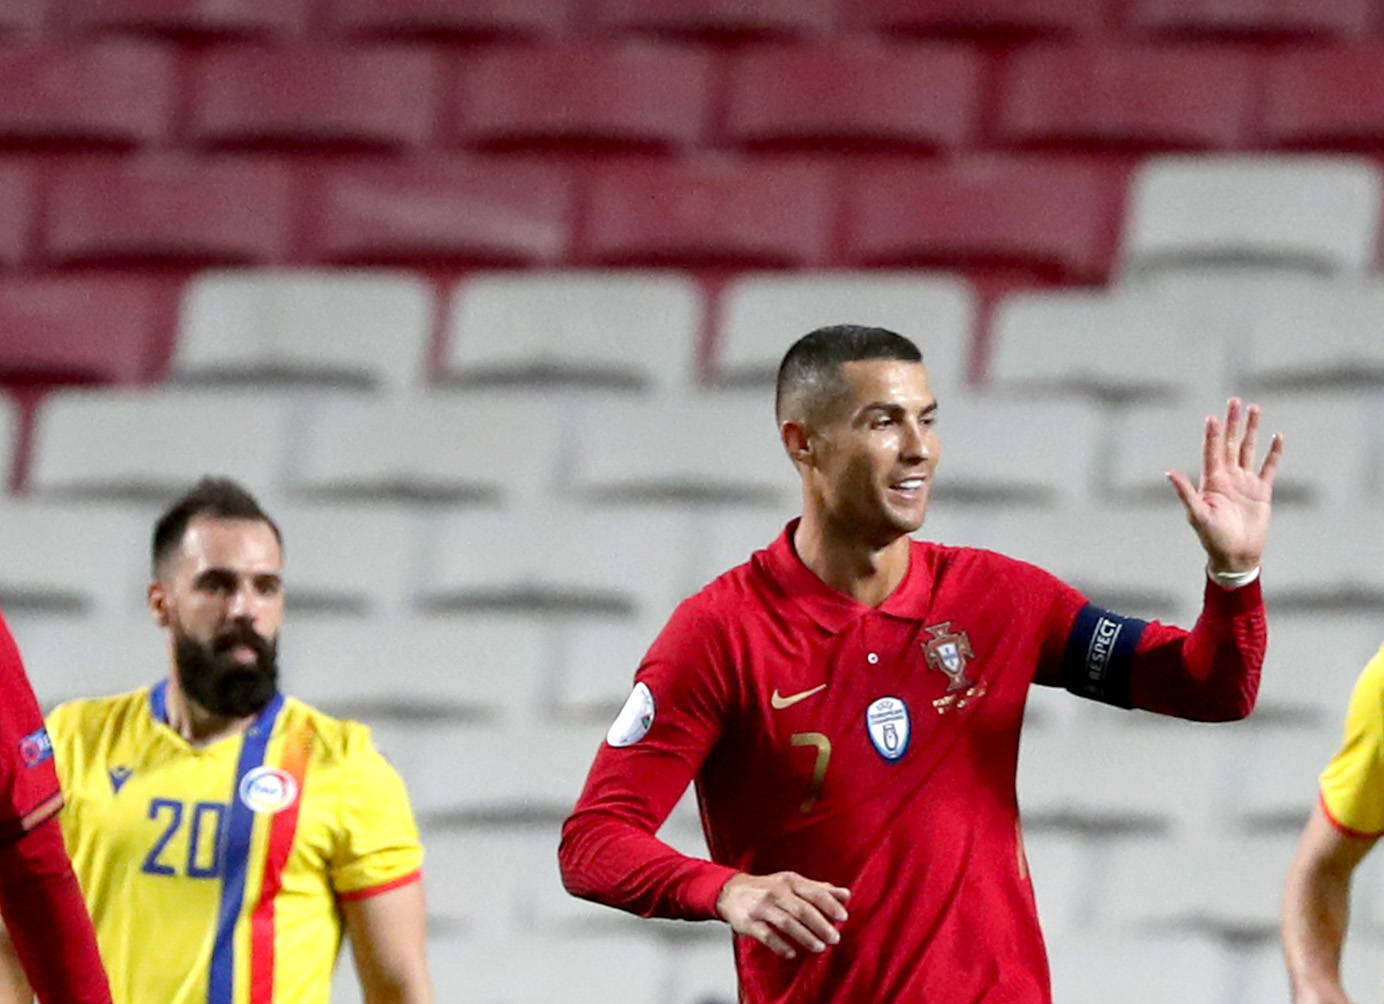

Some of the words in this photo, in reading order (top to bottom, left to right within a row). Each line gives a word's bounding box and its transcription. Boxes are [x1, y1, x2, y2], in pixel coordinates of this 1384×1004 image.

[1088, 619, 1117, 681] RESPECT
[791, 732, 833, 813] 7
[140, 797, 230, 879] 20
